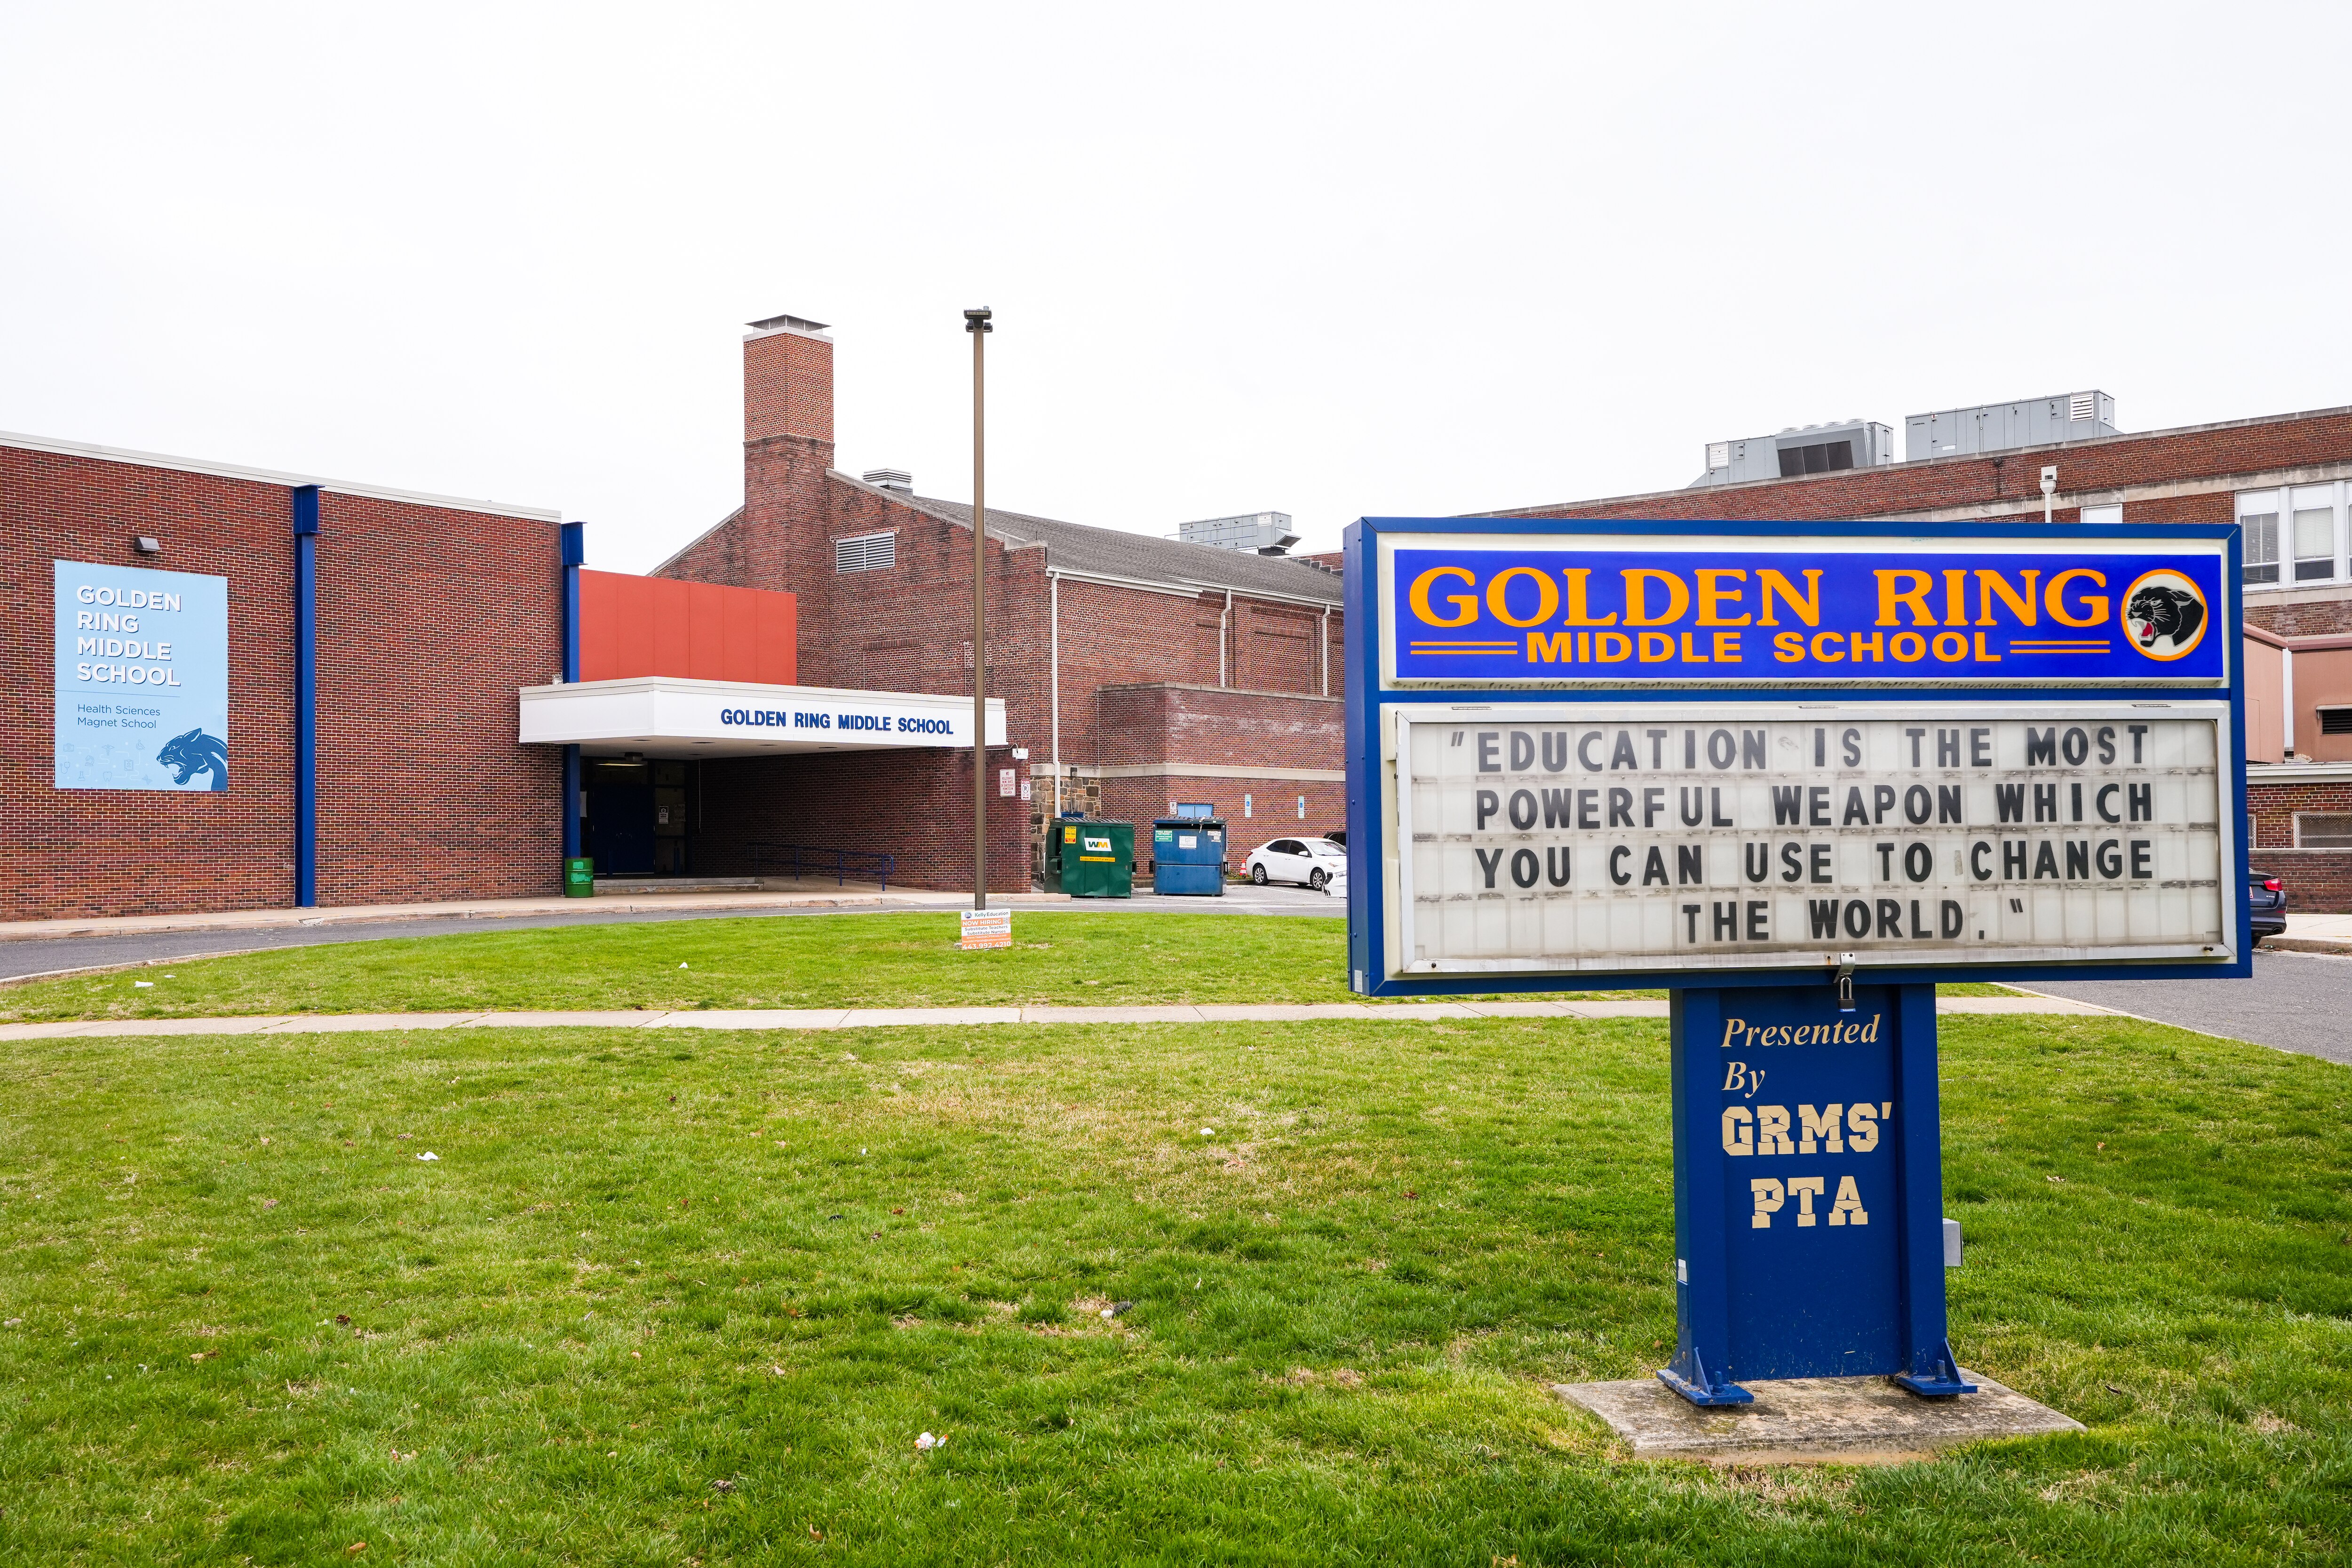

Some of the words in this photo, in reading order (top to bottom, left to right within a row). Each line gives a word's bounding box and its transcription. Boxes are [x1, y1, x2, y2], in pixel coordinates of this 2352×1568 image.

[77, 585, 181, 612] GOLDEN
[1409, 566, 1823, 628] GOLDEN
[1873, 569, 2110, 627] RING
[77, 611, 139, 633] RING
[78, 636, 171, 661] MIDDLE
[1527, 632, 1742, 663] MIDDLE
[1773, 632, 2001, 663] SCHOOL
[77, 662, 181, 686] SCHOOL
[78, 704, 111, 714] Health
[116, 706, 160, 716] Sciences
[78, 717, 118, 728] Magnet
[121, 719, 156, 729] School
[721, 708, 787, 727] GOLDEN
[795, 712, 831, 729] RING
[838, 715, 891, 731] MIDDLE
[898, 717, 954, 735] SCHOOL
[1815, 728, 1861, 767] IS
[1906, 728, 1992, 768] THE
[2026, 725, 2148, 767] MOST
[1476, 787, 1733, 831] POWERFUL
[1772, 784, 1962, 826] WEAPON
[1995, 783, 2153, 824] WHICH
[1475, 846, 1570, 889] YOU
[1609, 845, 1703, 886] CAN
[1745, 842, 1833, 883] USE
[1876, 842, 1932, 883] TO
[1971, 839, 2153, 881] CHANGE
[1683, 900, 1769, 943] THE
[962, 941, 1011, 950] 443.992.4210
[1721, 1014, 1881, 1047] Presented
[1723, 1062, 1765, 1098] By
[1722, 1101, 1892, 1156] GRMS'
[1751, 1175, 1868, 1229] PTA
